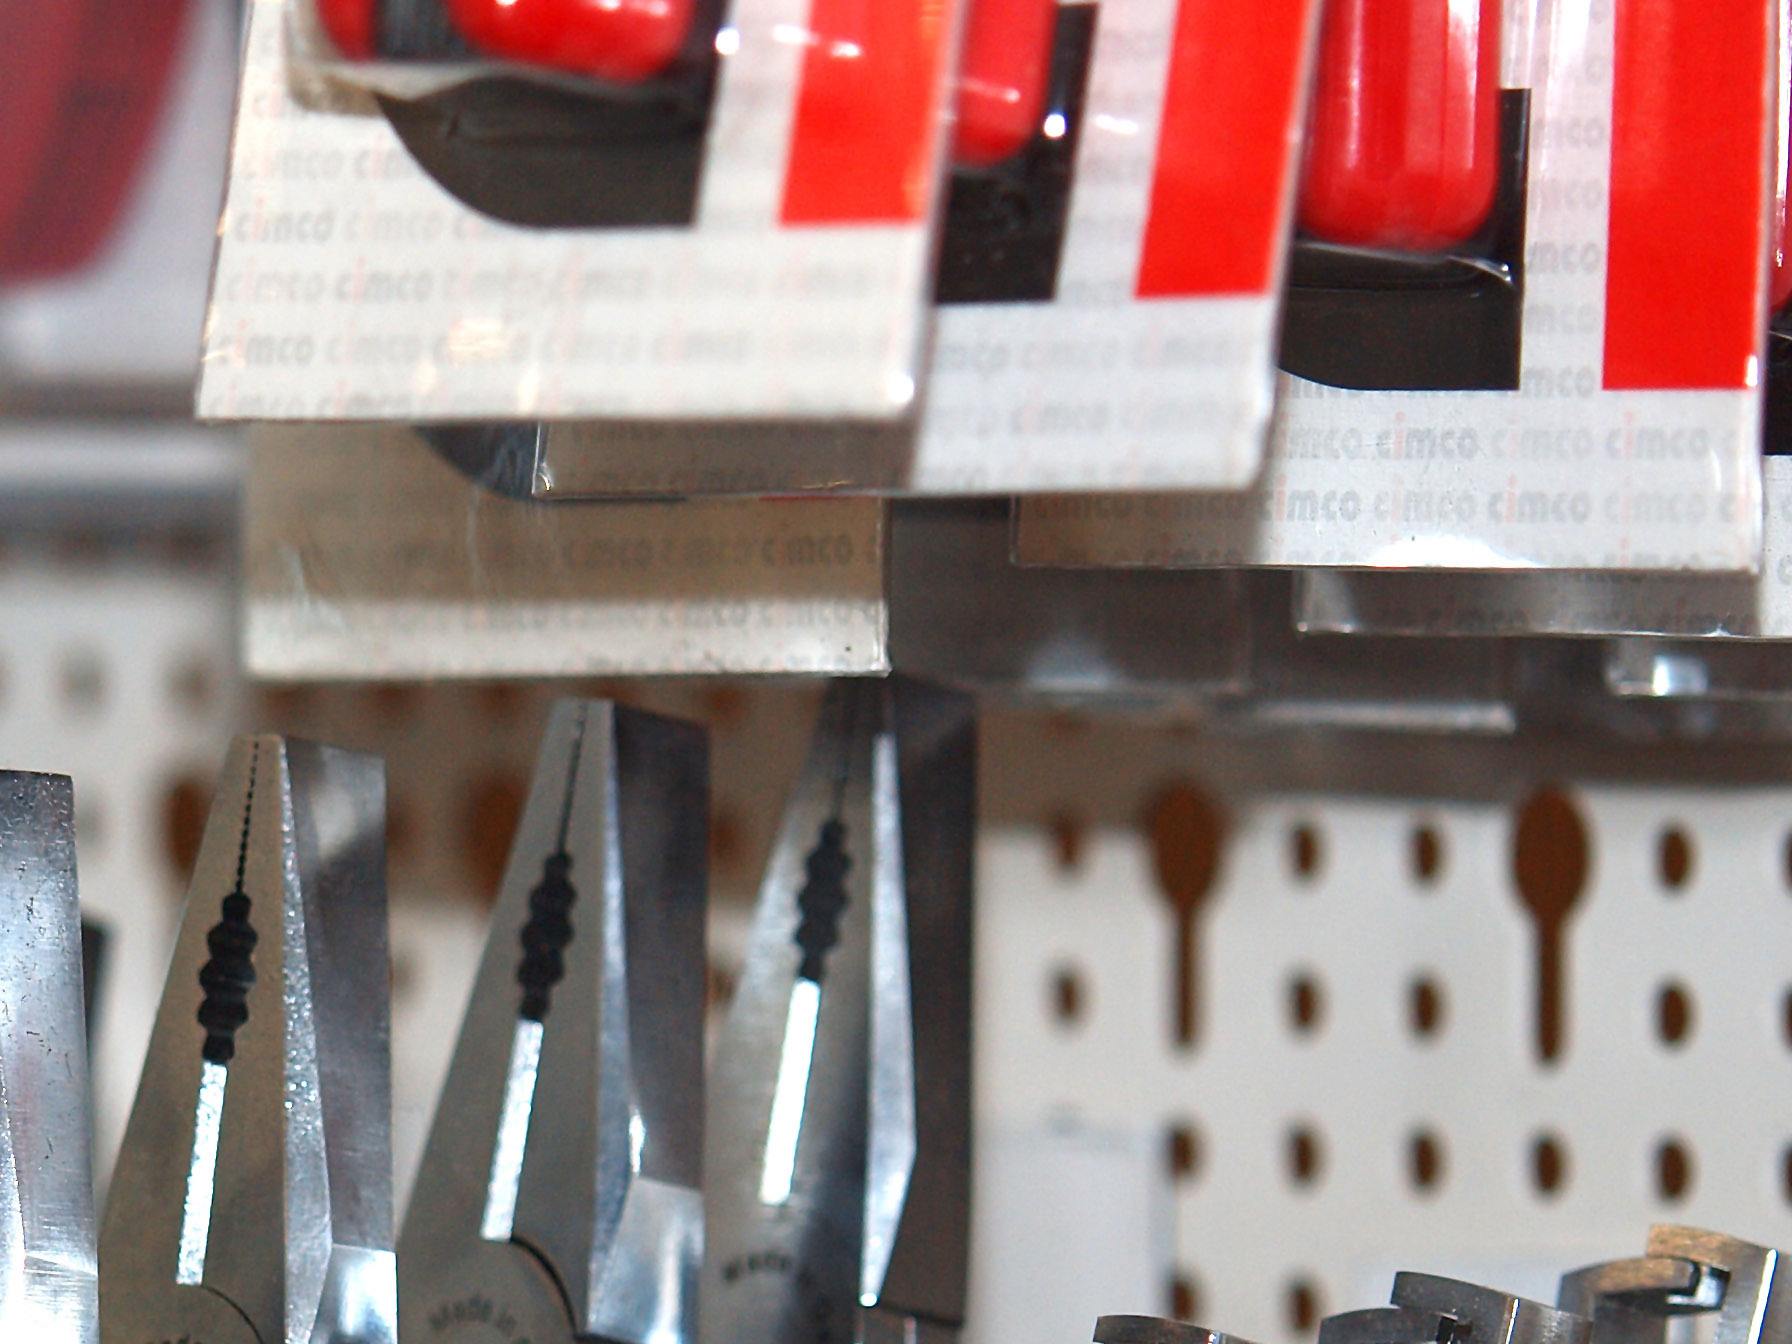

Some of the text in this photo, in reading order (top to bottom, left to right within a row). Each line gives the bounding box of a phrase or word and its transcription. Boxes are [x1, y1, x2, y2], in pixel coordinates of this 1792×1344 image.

[1527, 241, 1601, 275] mco
[1525, 303, 1597, 335] mco
[1521, 365, 1595, 398] mco
[1375, 410, 1480, 461] cimco
[1490, 413, 1594, 460] cimco
[1605, 410, 1709, 460] cimco
[1373, 473, 1476, 523] cimco
[1487, 473, 1592, 524] cimco
[761, 532, 854, 567] cmco
